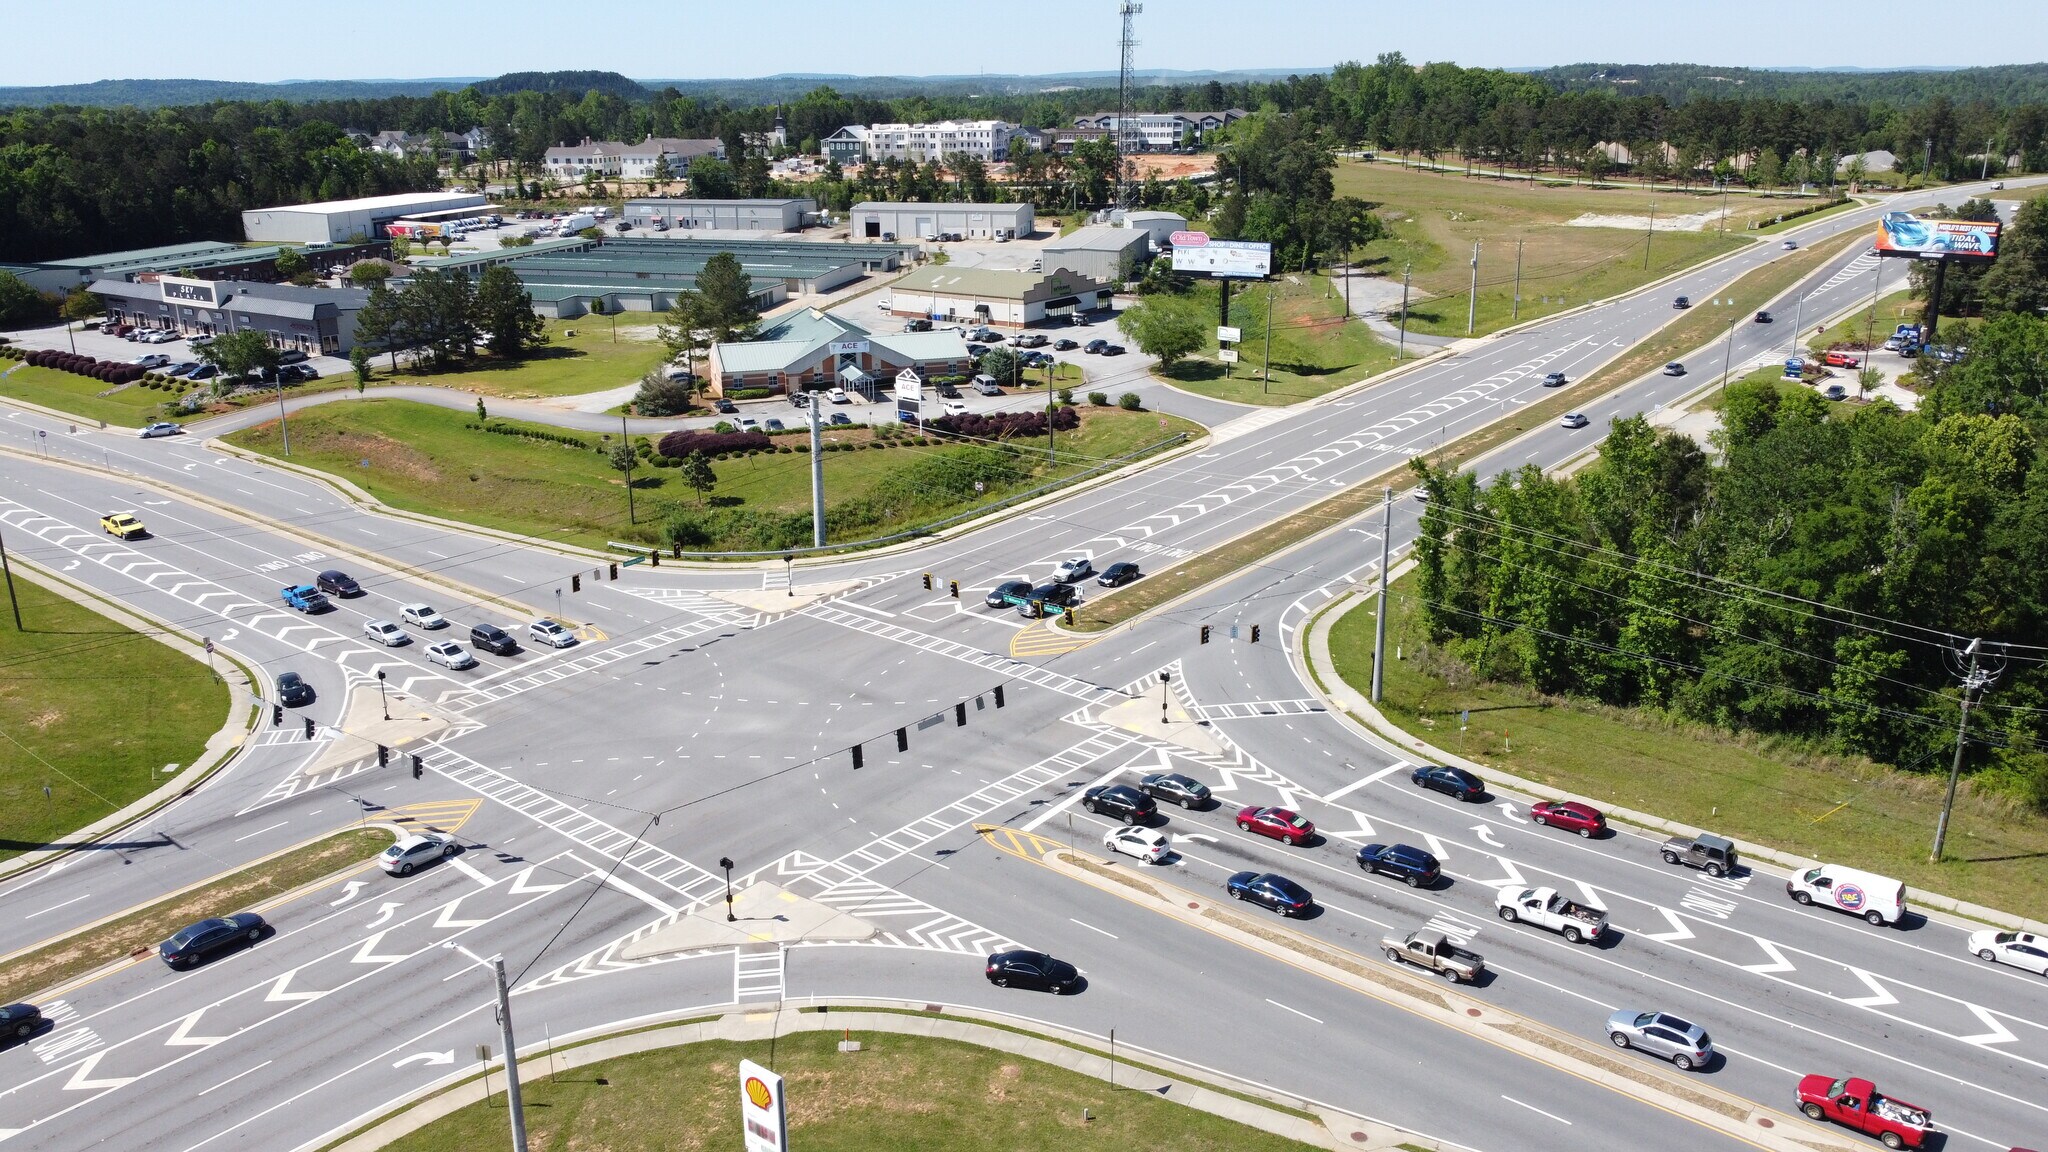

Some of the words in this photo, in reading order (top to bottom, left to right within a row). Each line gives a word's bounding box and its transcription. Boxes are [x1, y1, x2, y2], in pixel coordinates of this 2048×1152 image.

[181, 286, 194, 294] SKY
[173, 292, 204, 300] PLAZA
[841, 342, 858, 350] ACE
[901, 383, 914, 391] ACE
[1126, 541, 1163, 553] ONLY
[1157, 547, 1194, 558] ONLY
[292, 551, 327, 564] ONLY
[254, 560, 289, 573] ONLY
[1680, 886, 1739, 919] ONLY
[1841, 893, 1858, 901] RAC
[1421, 910, 1482, 945] ONLY
[32, 1027, 106, 1065] ONLY
